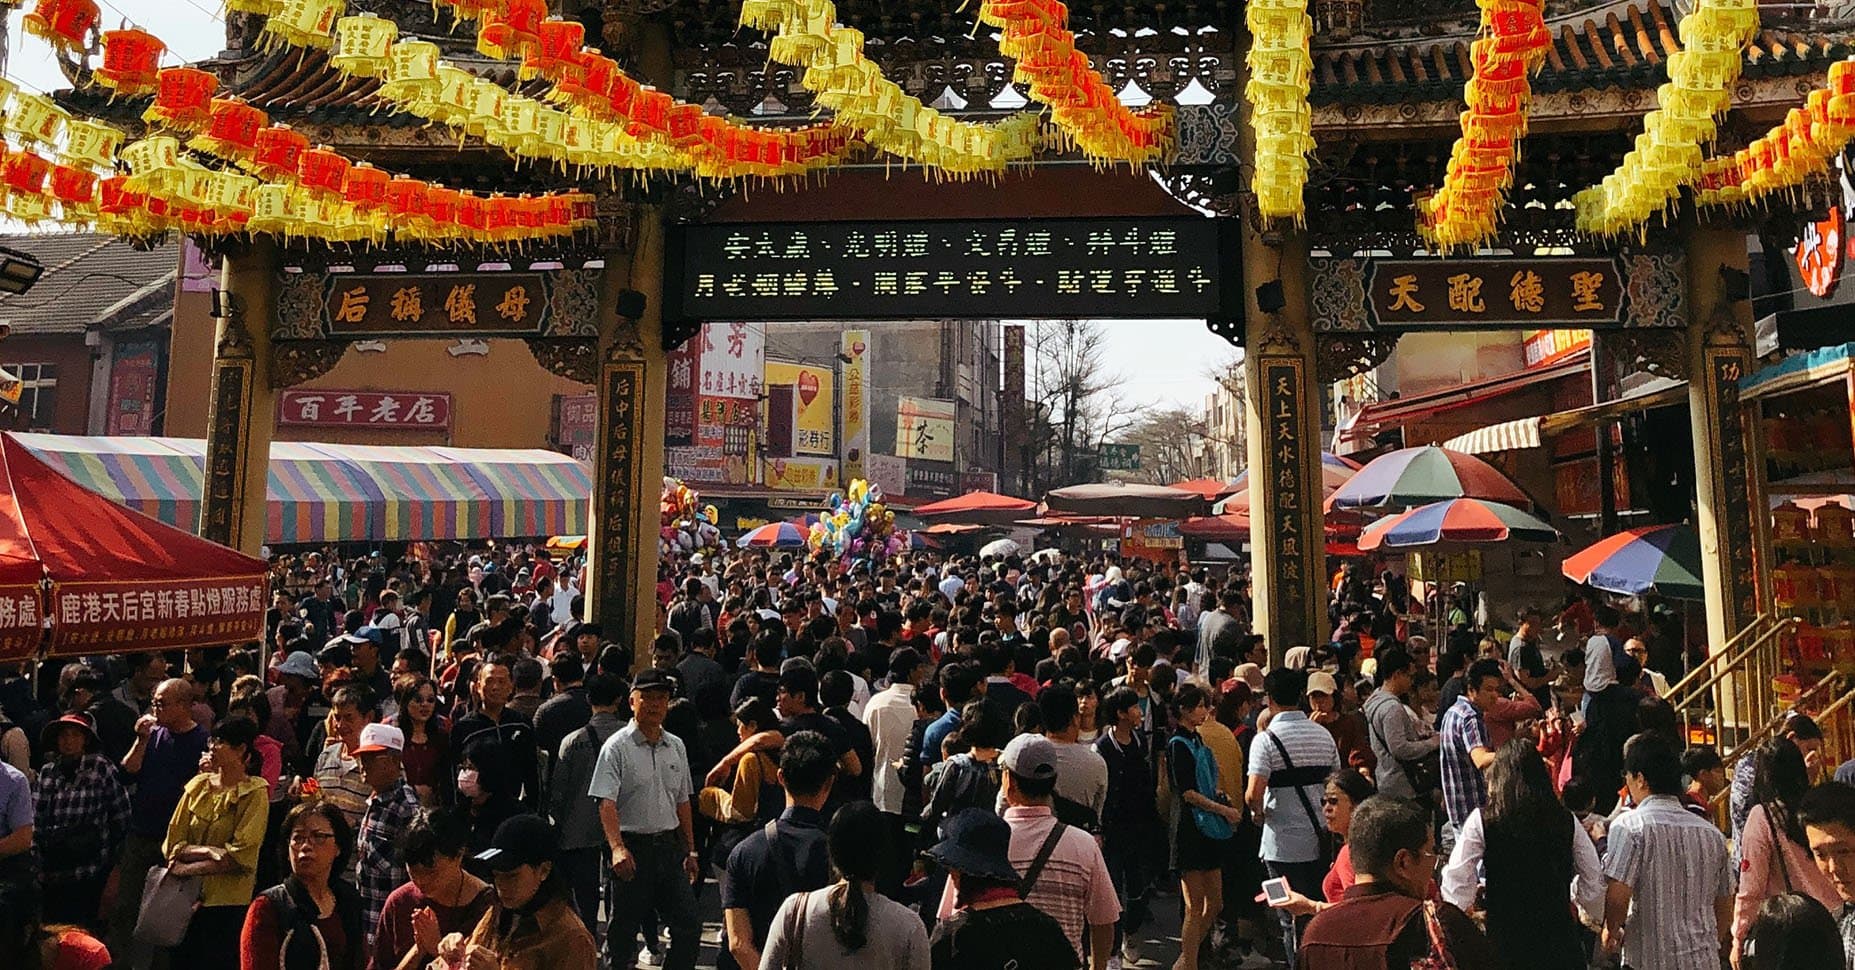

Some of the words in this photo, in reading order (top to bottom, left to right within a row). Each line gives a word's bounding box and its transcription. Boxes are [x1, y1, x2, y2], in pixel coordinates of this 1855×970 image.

[295, 396, 436, 423] 百年老店
[915, 419, 935, 455] 茶
[61, 585, 263, 625] 鹿港天后宮新春點燈服務處
